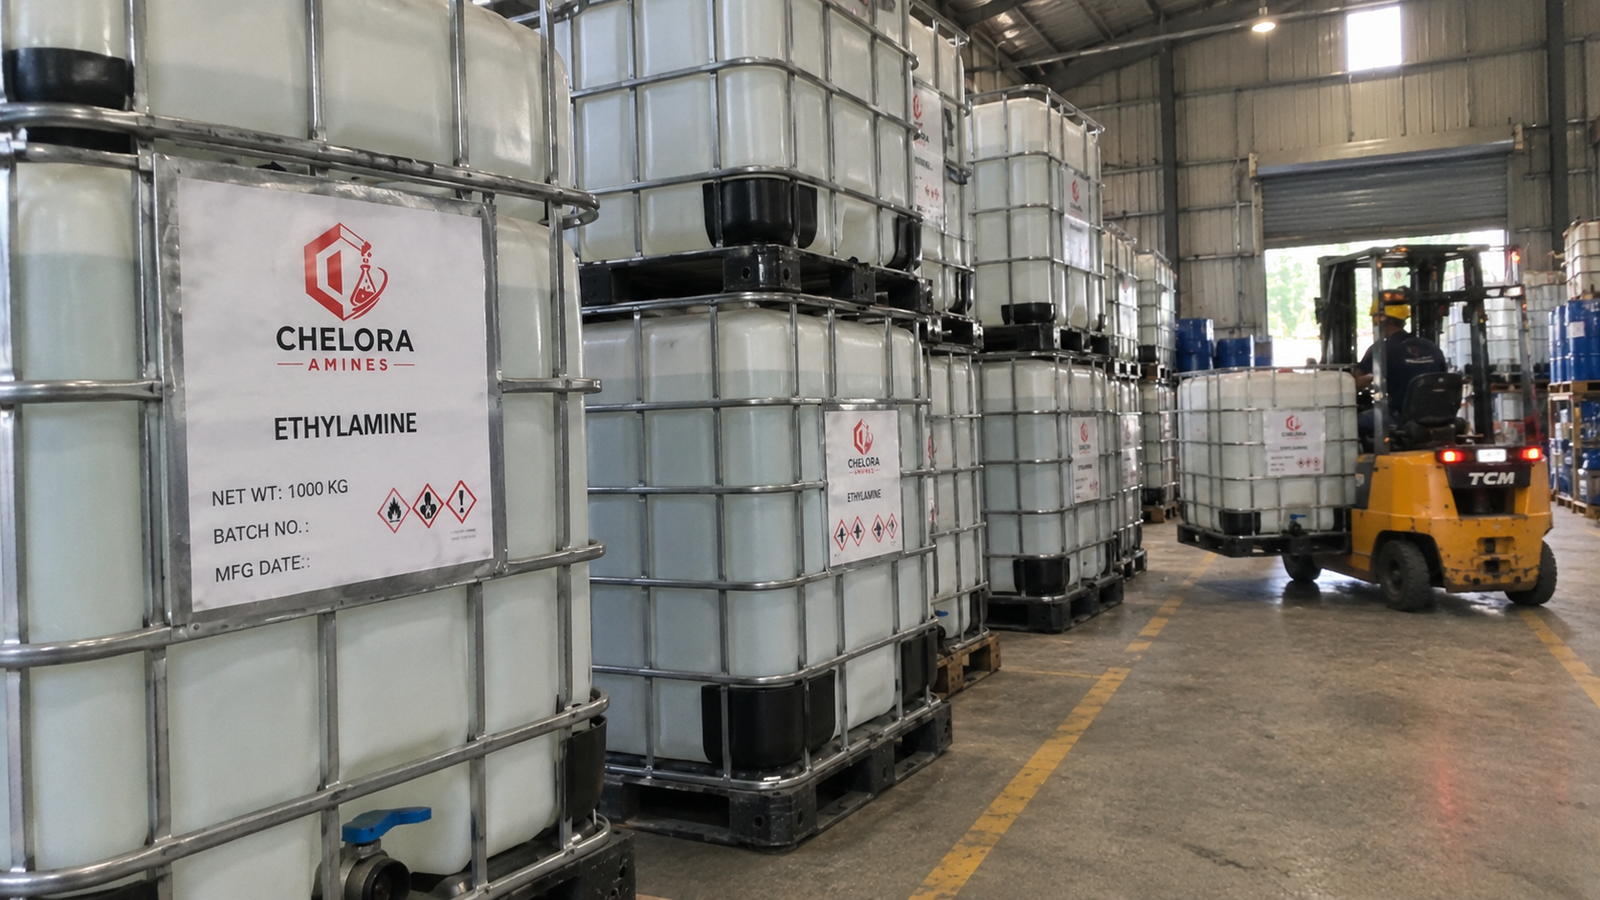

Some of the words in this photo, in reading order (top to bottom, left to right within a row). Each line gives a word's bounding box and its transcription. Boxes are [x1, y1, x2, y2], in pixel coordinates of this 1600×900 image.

[276, 326, 414, 353] CHELORA
[308, 358, 388, 372] AMINES
[274, 411, 418, 441] ETHYLAMINE
[847, 457, 880, 469] CHELORA
[1468, 471, 1515, 486] TCM
[211, 488, 247, 507] NET
[250, 485, 283, 503] WT:
[287, 481, 324, 499] 1000
[327, 479, 349, 495] KG
[847, 488, 882, 503] ETHYLAMINE
[213, 522, 270, 545] BATCH
[215, 562, 254, 583] MFG
